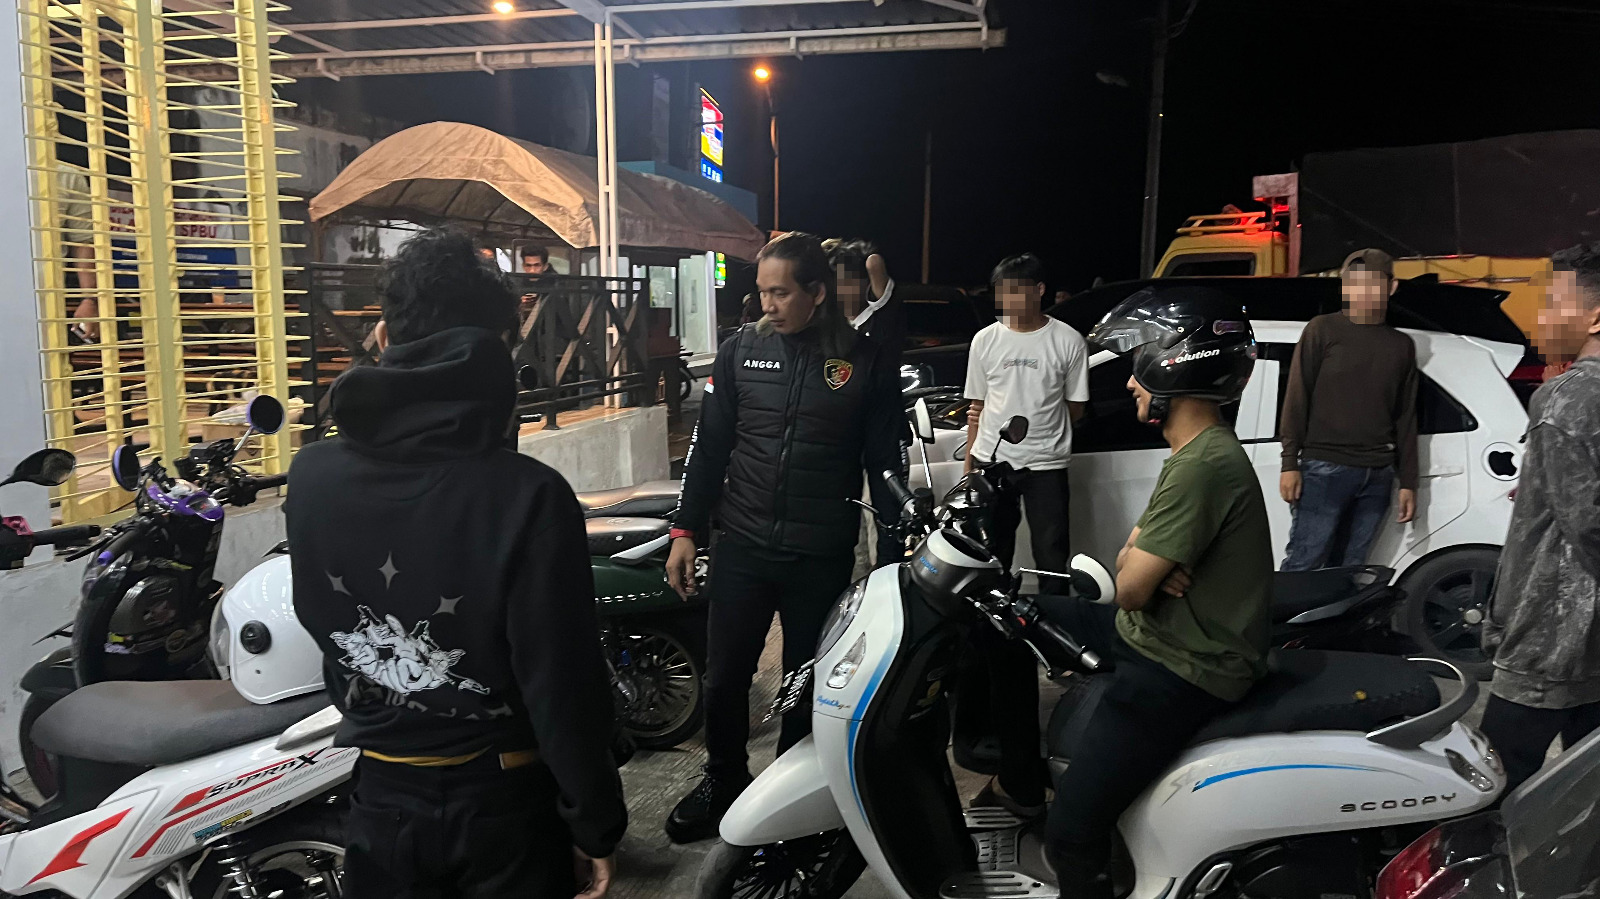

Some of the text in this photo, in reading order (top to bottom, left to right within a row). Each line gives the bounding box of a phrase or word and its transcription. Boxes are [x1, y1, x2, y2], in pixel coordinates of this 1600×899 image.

[180, 224, 217, 238] SPBU
[743, 360, 780, 369] ANGGA
[1340, 793, 1456, 812] SCOOPY
